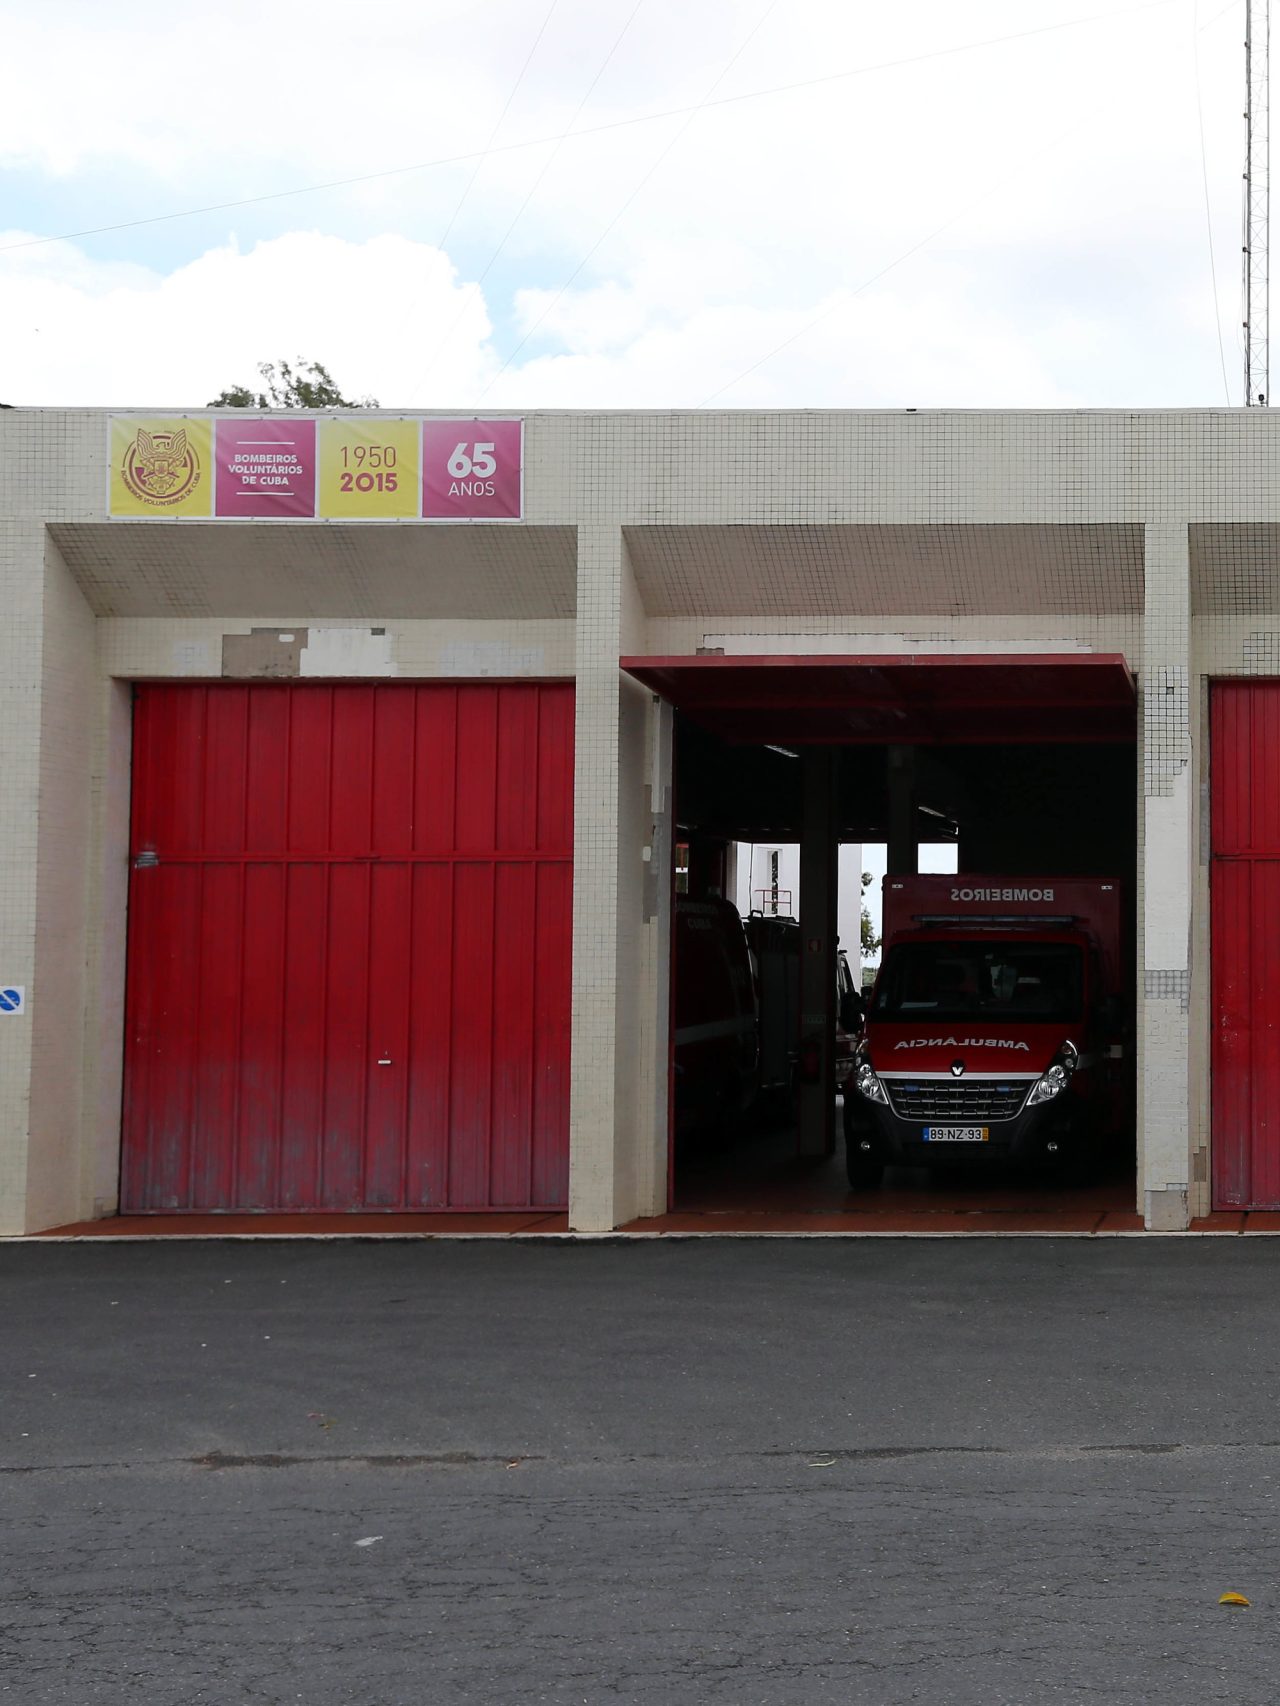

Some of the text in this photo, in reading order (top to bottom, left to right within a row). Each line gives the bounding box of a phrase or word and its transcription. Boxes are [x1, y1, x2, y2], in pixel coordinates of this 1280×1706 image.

[234, 454, 298, 463] BOMBEIROS
[340, 446, 397, 468] 1950
[447, 442, 497, 479] 65
[228, 464, 303, 475] VOLUNTÁRIOS
[242, 476, 289, 486] DE CUBA
[340, 472, 398, 493] 2015
[448, 481, 495, 496] ANOS
